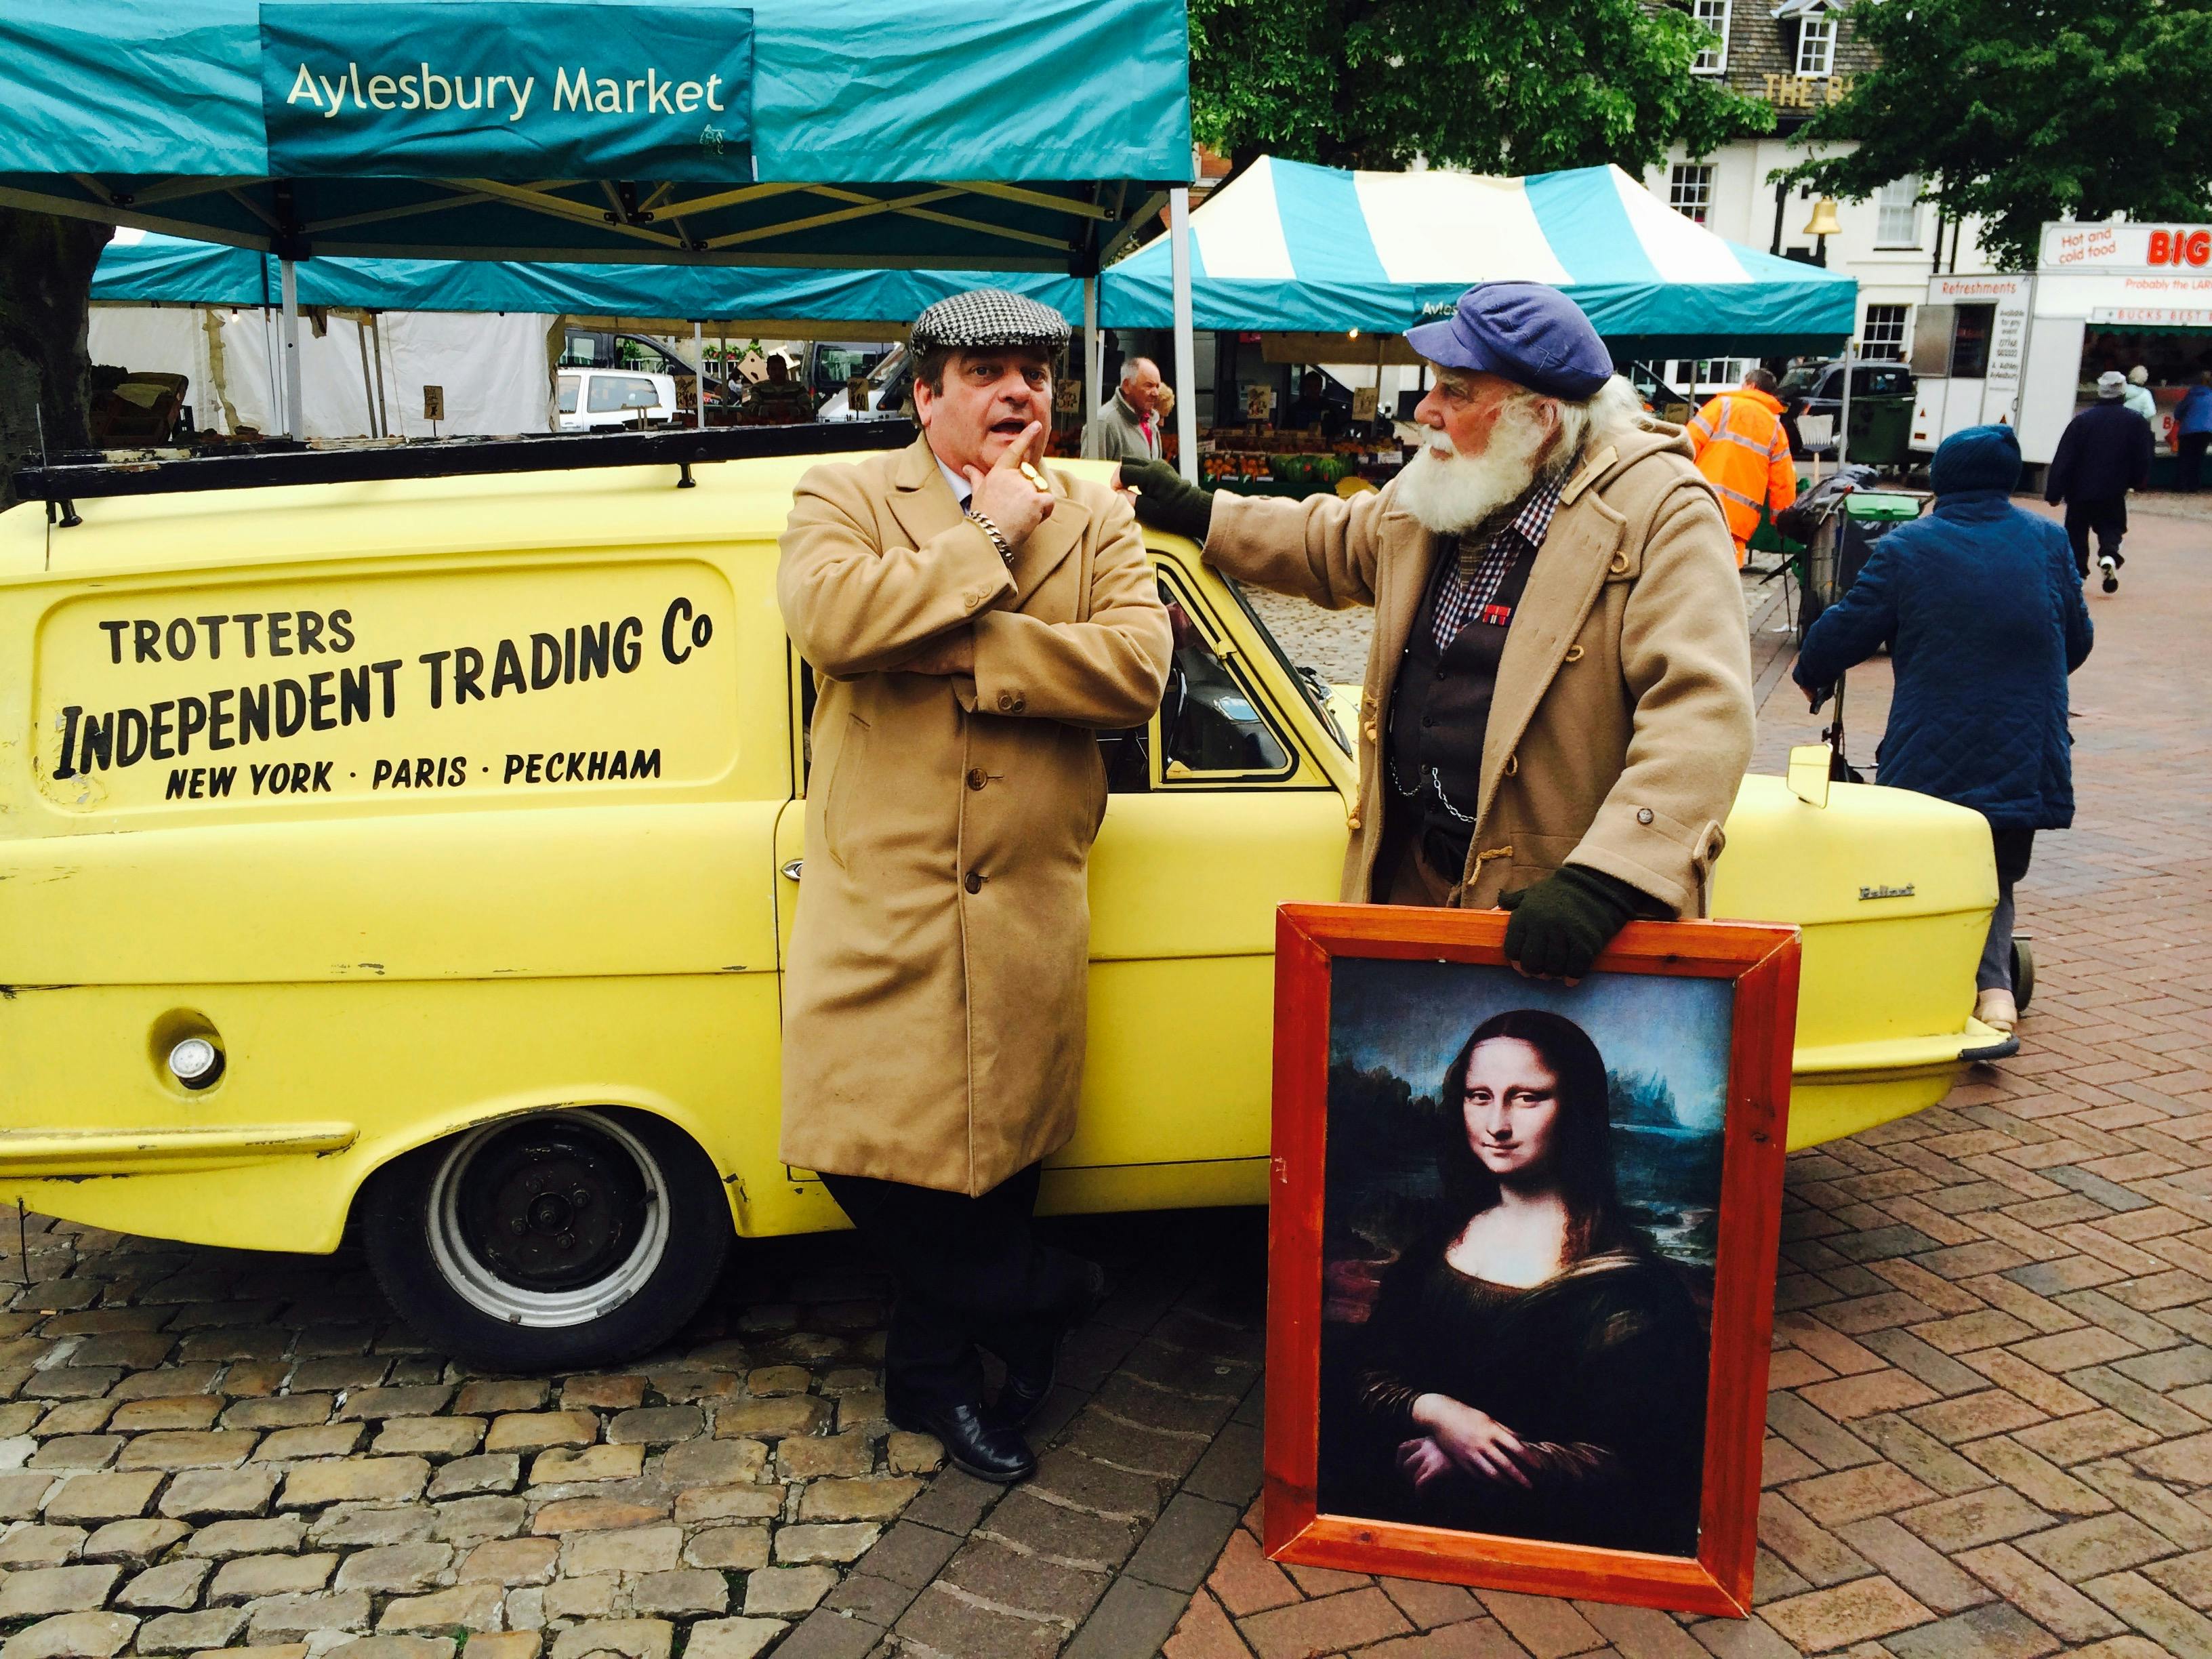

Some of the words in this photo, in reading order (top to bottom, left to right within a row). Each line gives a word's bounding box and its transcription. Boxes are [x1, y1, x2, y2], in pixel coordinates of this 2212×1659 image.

[287, 62, 534, 121] Aylesbury
[553, 66, 724, 114] Market
[1763, 73, 1818, 108] THE
[2059, 249, 2085, 264] cold
[2088, 241, 2116, 258] food
[2062, 233, 2084, 249] Hot
[2088, 228, 2112, 243] and
[2146, 229, 2212, 268] BIG
[1942, 281, 2017, 294] Refreshments
[2125, 278, 2170, 291] Probably
[2173, 278, 2188, 290] the
[2192, 279, 2212, 290] LAR
[1422, 300, 1459, 316] Ayles
[2116, 309, 2162, 321] BUCKS
[2170, 310, 2202, 322] BEST
[98, 609, 355, 665] TROTTERS
[52, 659, 403, 781] INDEPENDENT
[418, 616, 643, 710] TRADING
[661, 597, 714, 665] Co
[165, 766, 237, 800] NEW
[250, 761, 333, 796] YORK
[372, 756, 467, 790] PARIS
[504, 748, 661, 784] PECKHAM
